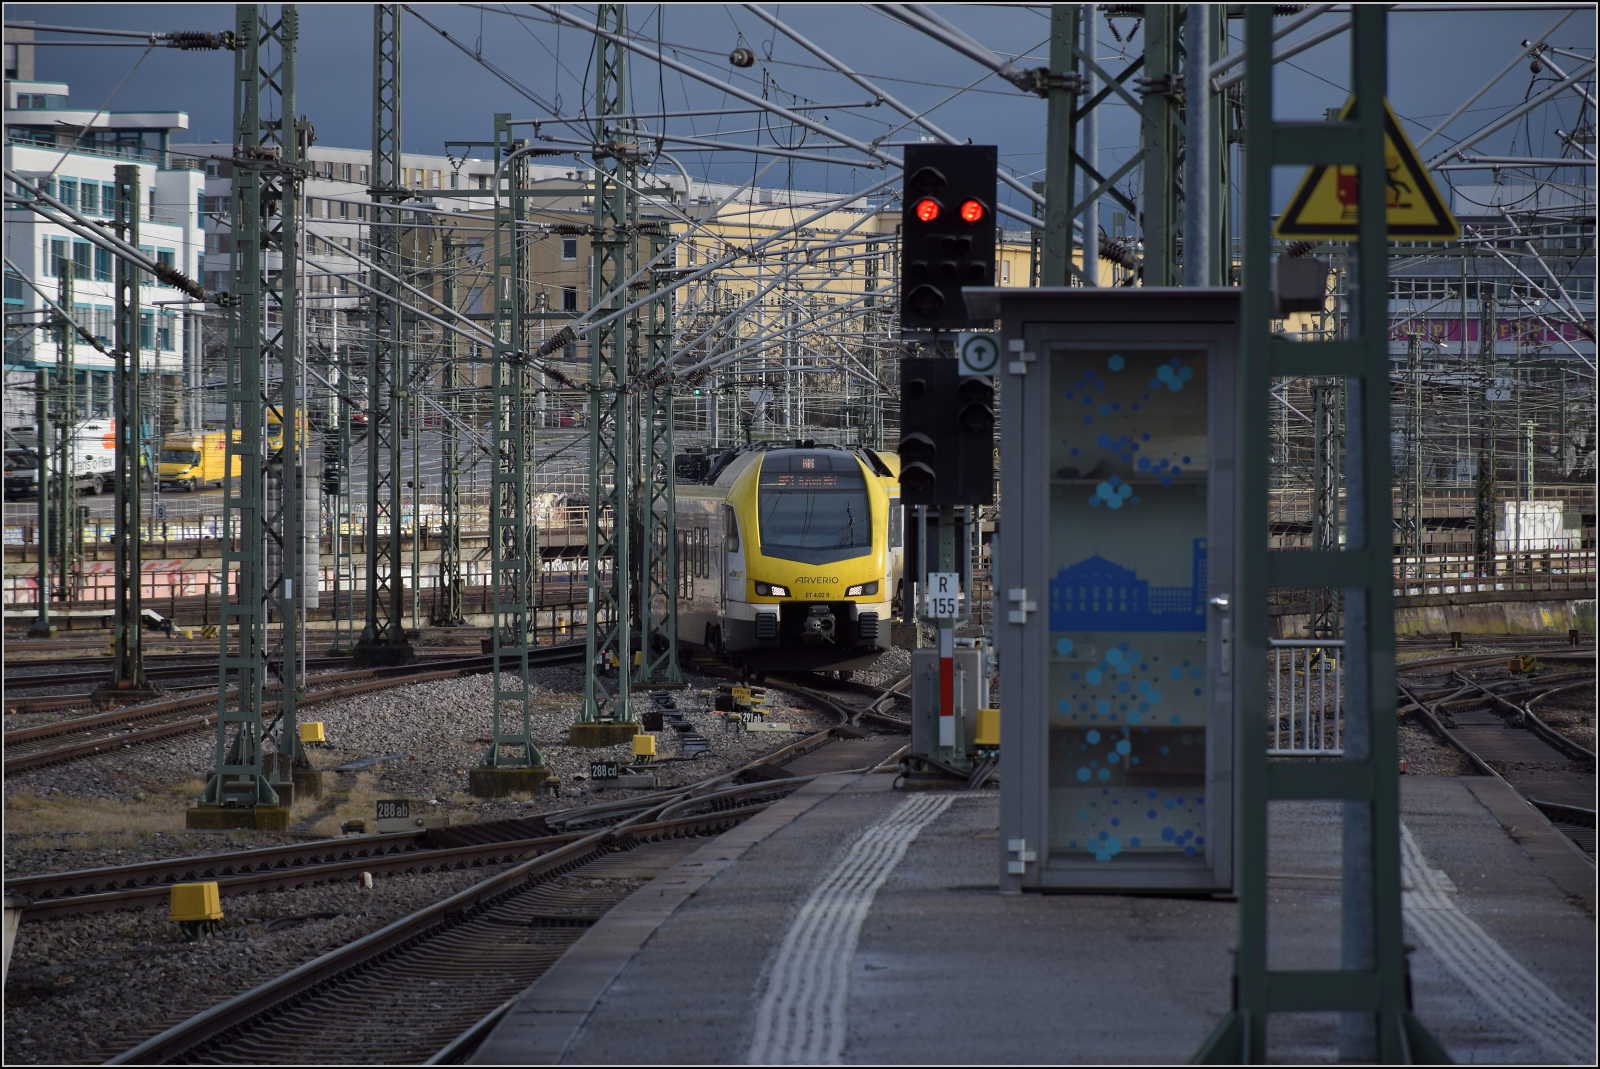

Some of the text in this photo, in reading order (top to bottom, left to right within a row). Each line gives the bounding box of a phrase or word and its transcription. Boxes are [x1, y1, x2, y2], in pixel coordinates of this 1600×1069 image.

[1494, 389, 1502, 400] 9
[158, 507, 164, 518] 9
[795, 576, 839, 584] ARVERIO
[939, 576, 948, 593] R
[932, 598, 955, 614] 155
